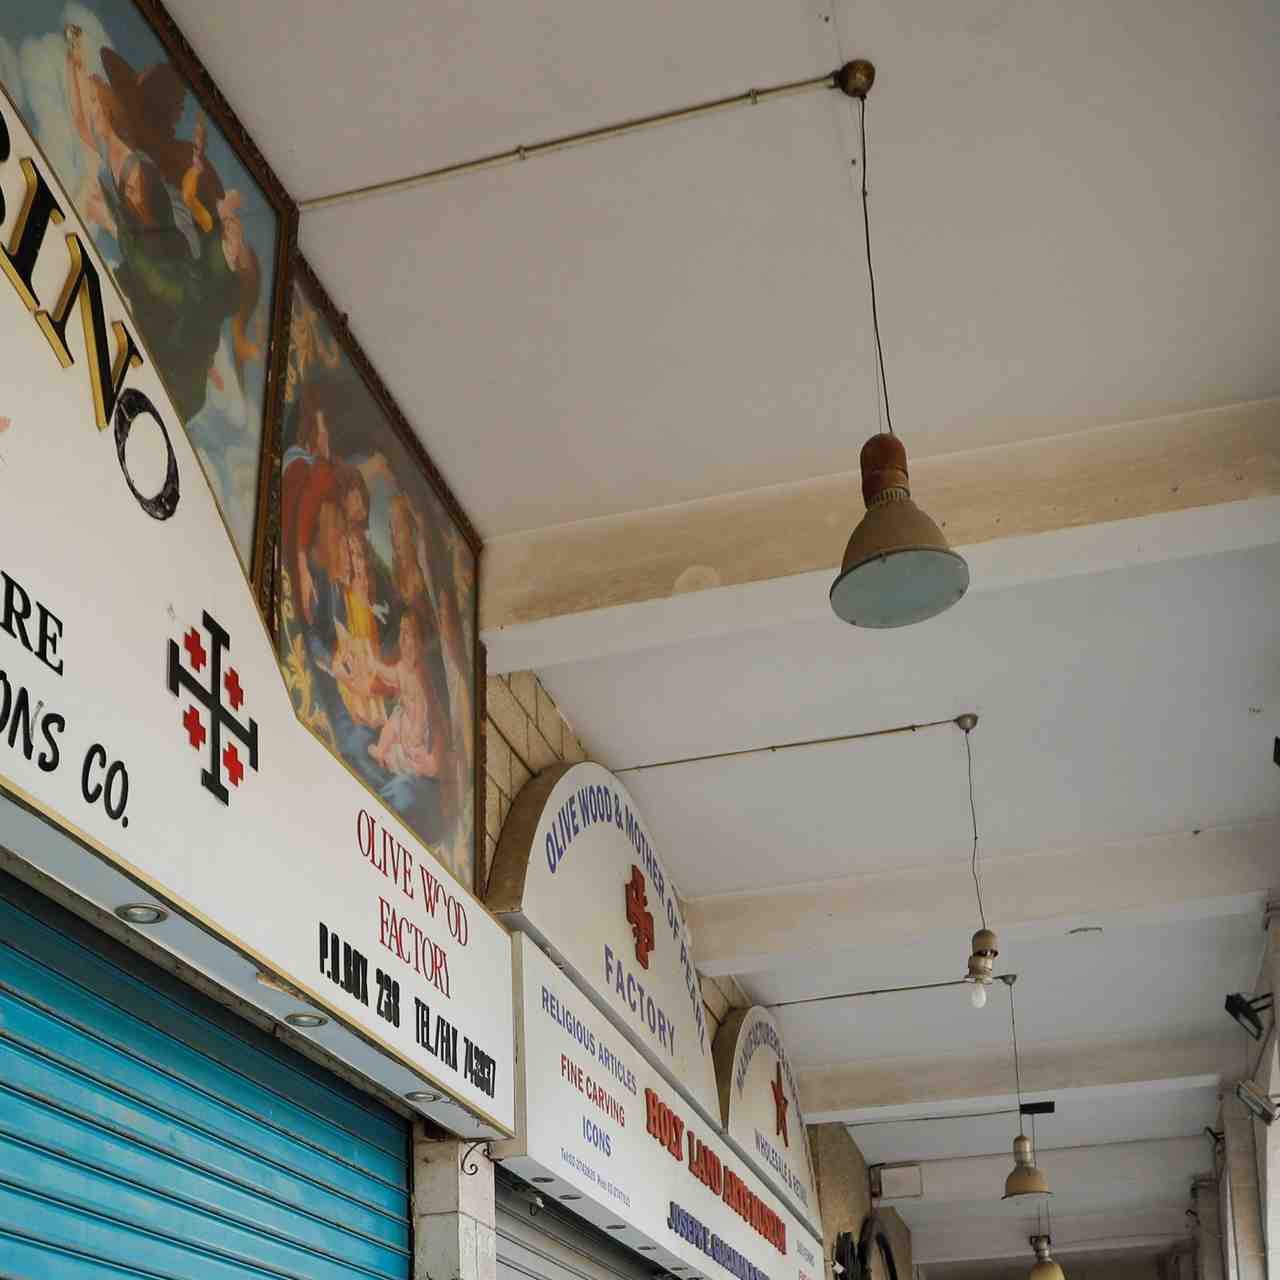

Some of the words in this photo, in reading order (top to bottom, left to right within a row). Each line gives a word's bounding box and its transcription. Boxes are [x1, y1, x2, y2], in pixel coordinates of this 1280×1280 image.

[81, 742, 130, 828] CO.
[357, 808, 414, 899] OLIVE
[545, 795, 580, 874] OLIVE
[577, 784, 613, 828] WOOD
[625, 804, 665, 905] MOTHER
[667, 898, 680, 941] OF
[541, 985, 596, 1057] RELIGIOUS
[598, 1041, 637, 1096] ARTICLES
[604, 943, 675, 1057] FACTORY
[560, 1053, 584, 1094] FINE
[585, 1075, 625, 1128] CARVING
[582, 1115, 612, 1158] ICONS
